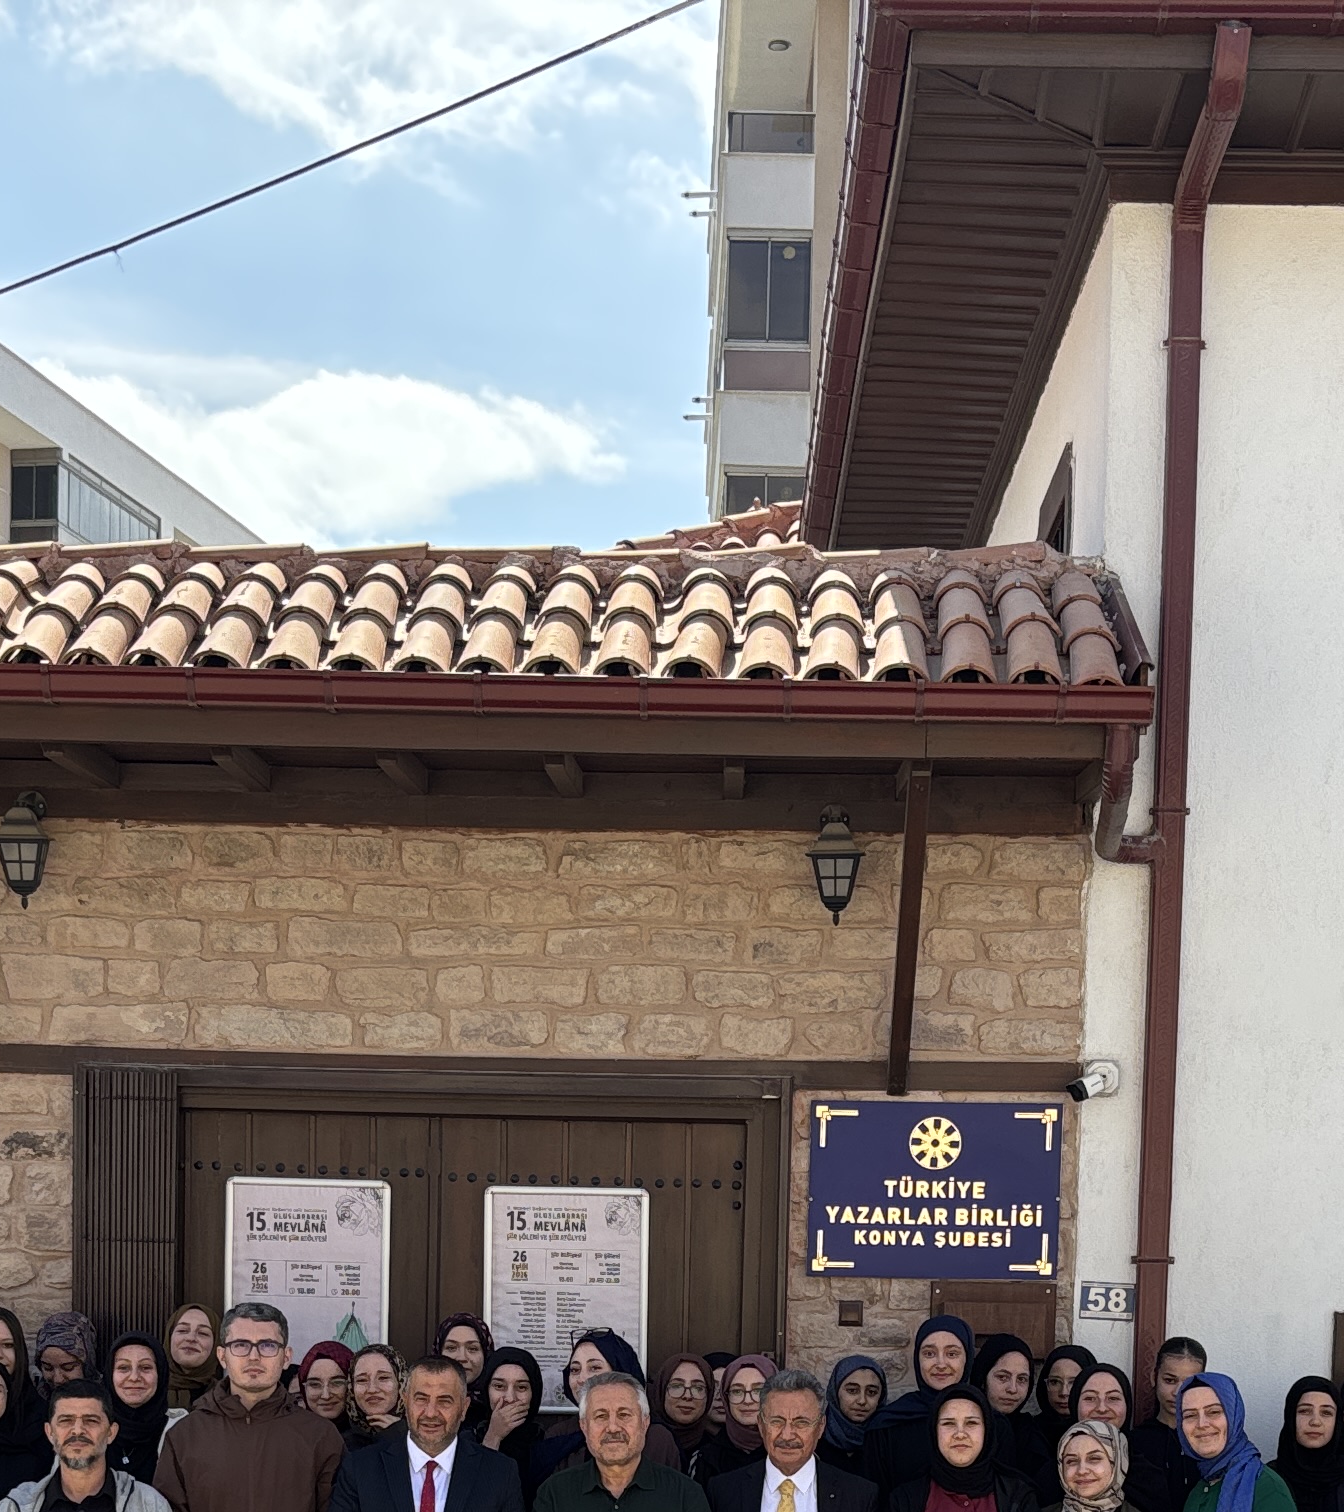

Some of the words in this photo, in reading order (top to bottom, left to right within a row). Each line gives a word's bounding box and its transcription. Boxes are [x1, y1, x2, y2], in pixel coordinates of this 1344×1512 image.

[884, 1176, 986, 1199] TÜRKİYE
[825, 1206, 948, 1226] YAZARLAR
[954, 1203, 1043, 1227] BİRLİĞİ
[273, 1220, 326, 1233] MEVLÂNÂ
[533, 1219, 586, 1232] MEVLÂNÂ
[854, 1230, 925, 1247] KONYA
[933, 1228, 1011, 1248] ŞUBESİ
[513, 1250, 527, 1262] 26
[253, 1262, 267, 1274] 26
[1087, 1287, 1127, 1312] 58
